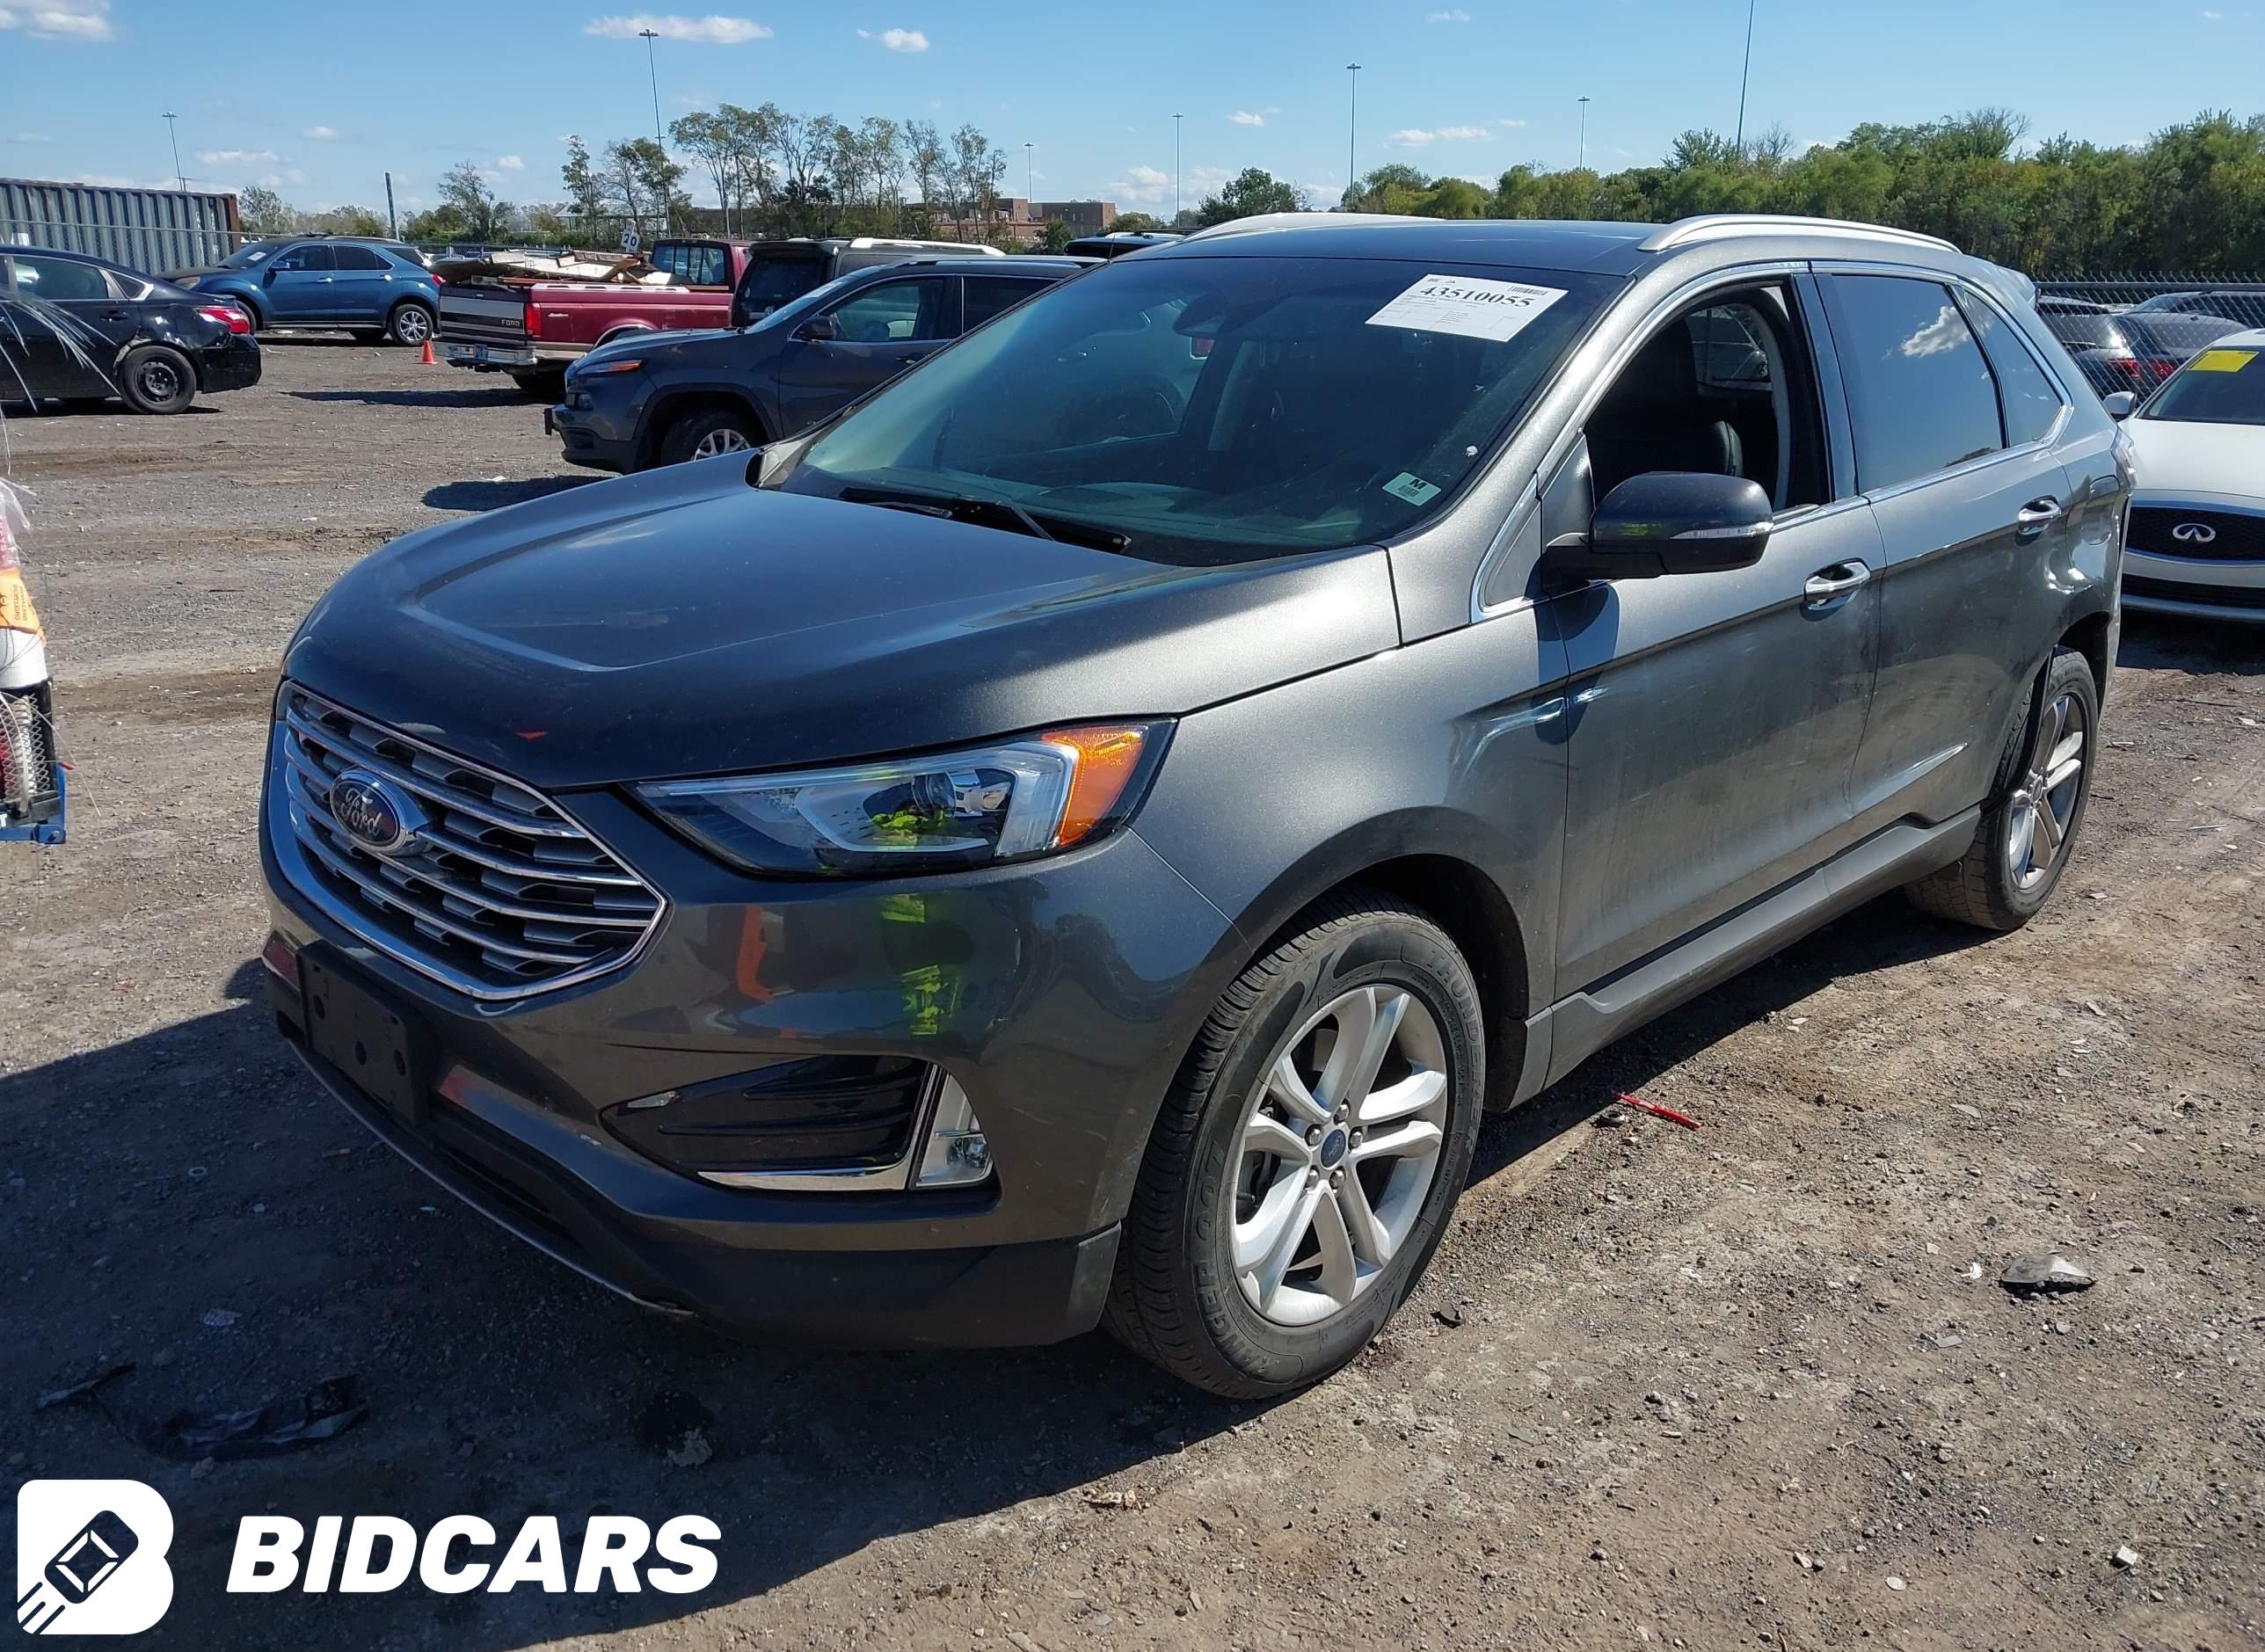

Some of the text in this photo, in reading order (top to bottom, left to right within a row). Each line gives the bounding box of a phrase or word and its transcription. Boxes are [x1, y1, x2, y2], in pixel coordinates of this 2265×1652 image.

[623, 233, 637, 247] 20
[1420, 285, 1535, 308] 43510055
[1409, 479, 1427, 490] M
[340, 787, 382, 836] Ford
